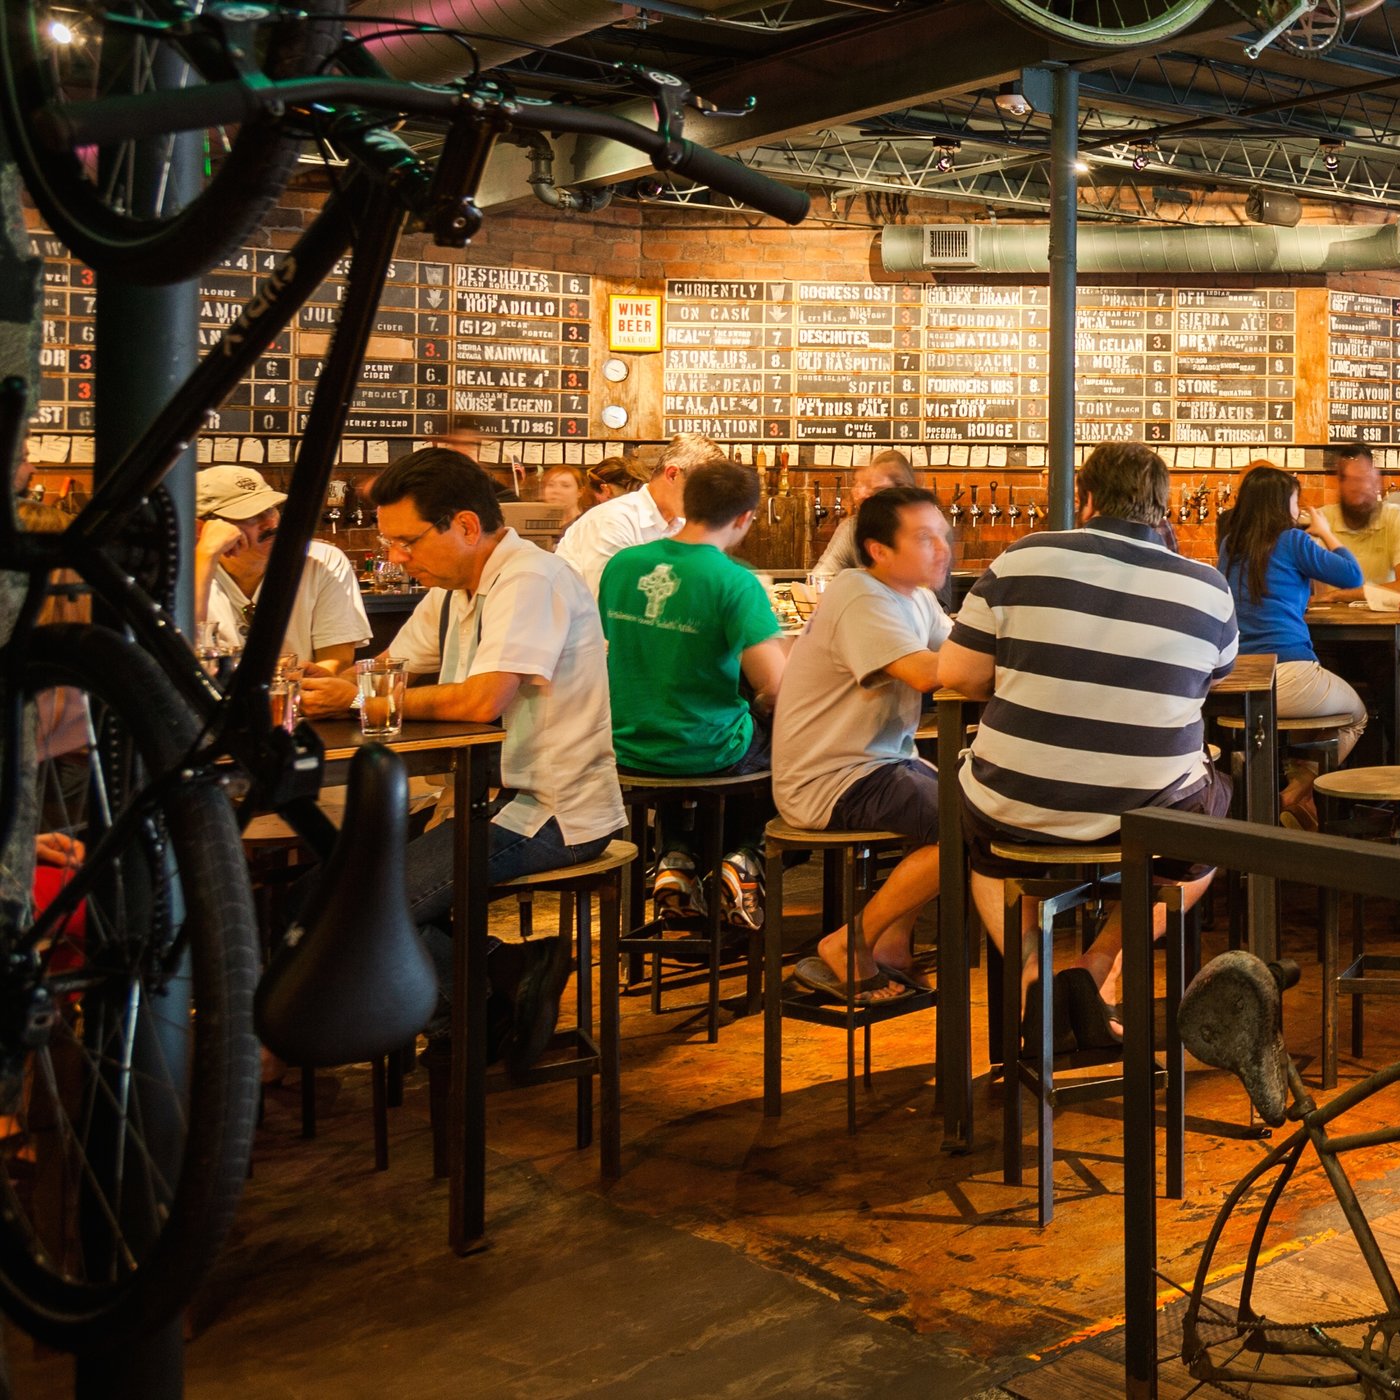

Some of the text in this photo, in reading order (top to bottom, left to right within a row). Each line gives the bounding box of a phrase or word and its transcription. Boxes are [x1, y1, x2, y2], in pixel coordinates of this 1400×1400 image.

[457, 267, 549, 287] DESCHUTES
[674, 283, 757, 298] CURRENTLY
[800, 286, 860, 300] ROGNESS
[466, 299, 555, 316] HOPADILLO
[618, 303, 652, 316] WINE
[680, 306, 750, 321] ON CASK
[618, 319, 652, 332] BEER
[1180, 313, 1230, 327] SIERRA
[459, 321, 497, 336] (512)
[800, 330, 869, 344] DESCHUTES
[955, 333, 1019, 347] MATILDA
[670, 350, 718, 364] STONE
[1331, 342, 1375, 357] TUMBLER
[928, 354, 1012, 367] RODENBACH
[457, 370, 527, 387] REAL ALE
[723, 378, 762, 392] DEAD
[927, 378, 988, 393] FOUNDERS
[848, 381, 890, 393] SOFIE
[1178, 379, 1218, 394] STONE
[502, 398, 553, 412] LEGEND
[797, 402, 888, 417] PETRUS PALE
[926, 403, 985, 418] VICTORY
[669, 419, 757, 433] LIBERATION
[967, 423, 1013, 438] ROUGE
[1329, 424, 1382, 441] STONE SSR
